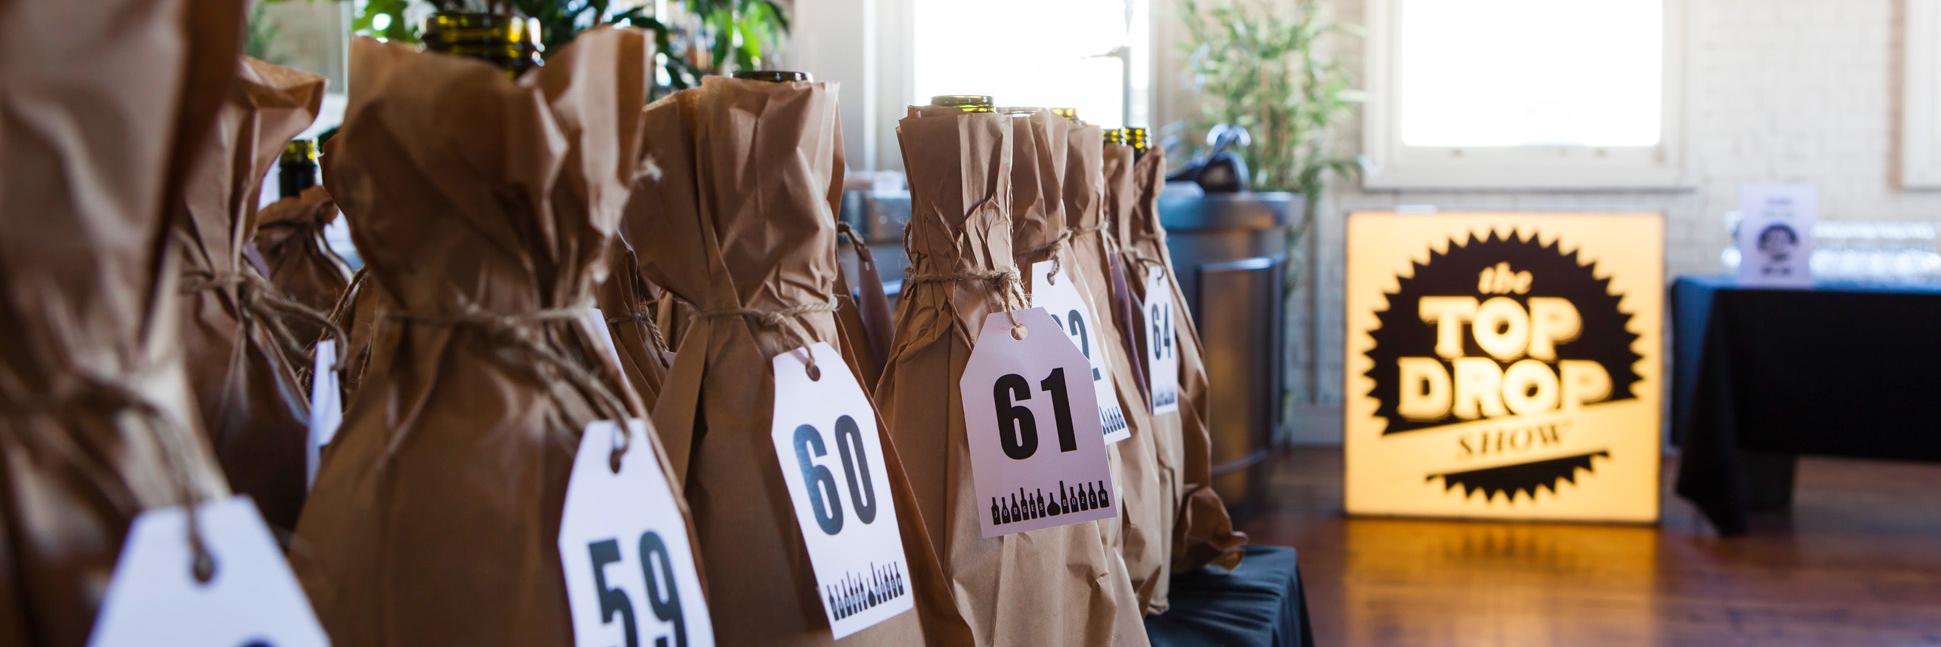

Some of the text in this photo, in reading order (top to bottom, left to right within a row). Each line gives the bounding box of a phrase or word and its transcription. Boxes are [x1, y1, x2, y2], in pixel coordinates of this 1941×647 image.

[1478, 262, 1533, 294] the
[1152, 303, 1171, 361] 64
[1418, 296, 1583, 362] TOP
[993, 367, 1077, 460] 61
[1396, 356, 1614, 420] DROP
[1457, 421, 1570, 457] SHOW
[793, 414, 877, 535] 60
[587, 530, 688, 647] 59
